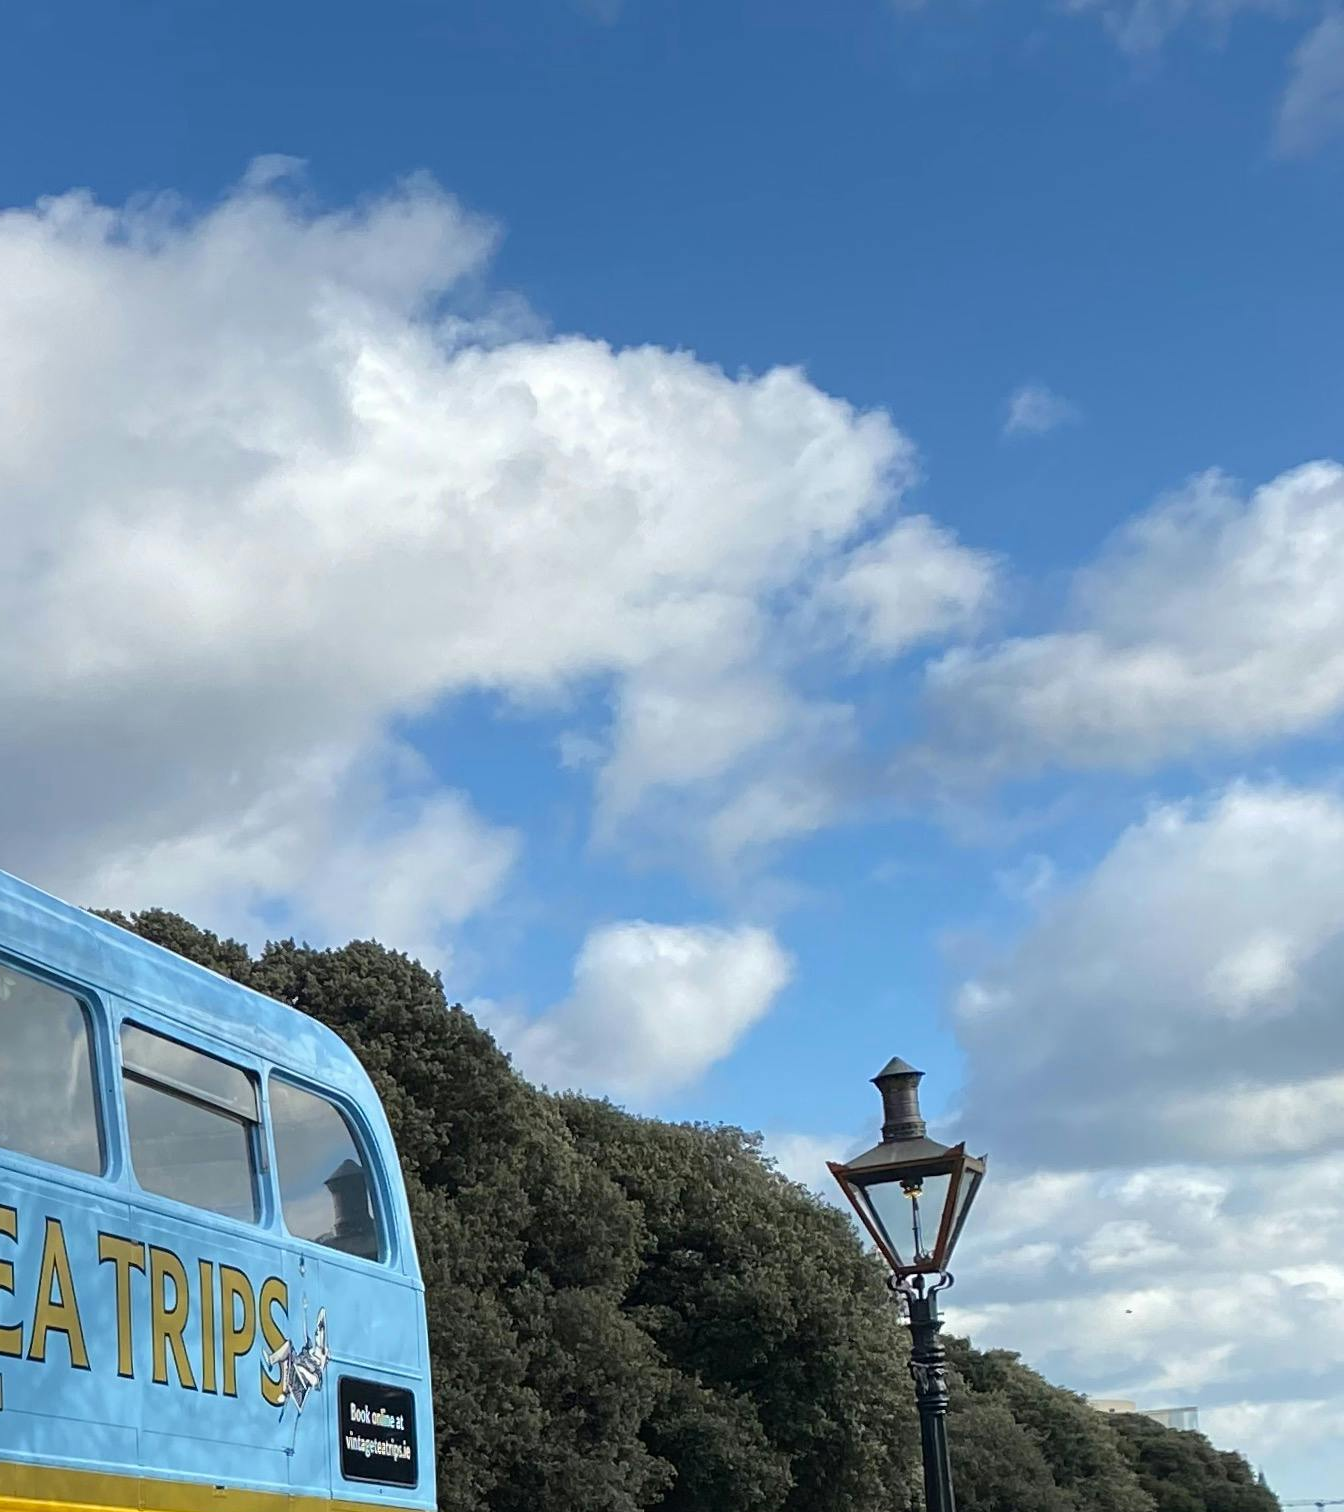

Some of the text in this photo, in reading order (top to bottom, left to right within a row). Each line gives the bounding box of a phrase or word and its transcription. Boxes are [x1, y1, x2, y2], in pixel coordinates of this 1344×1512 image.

[98, 1230, 290, 1408] TRIPS
[350, 1402, 404, 1430] Book online at
[346, 1430, 411, 1461] vintageteatrips.ie
